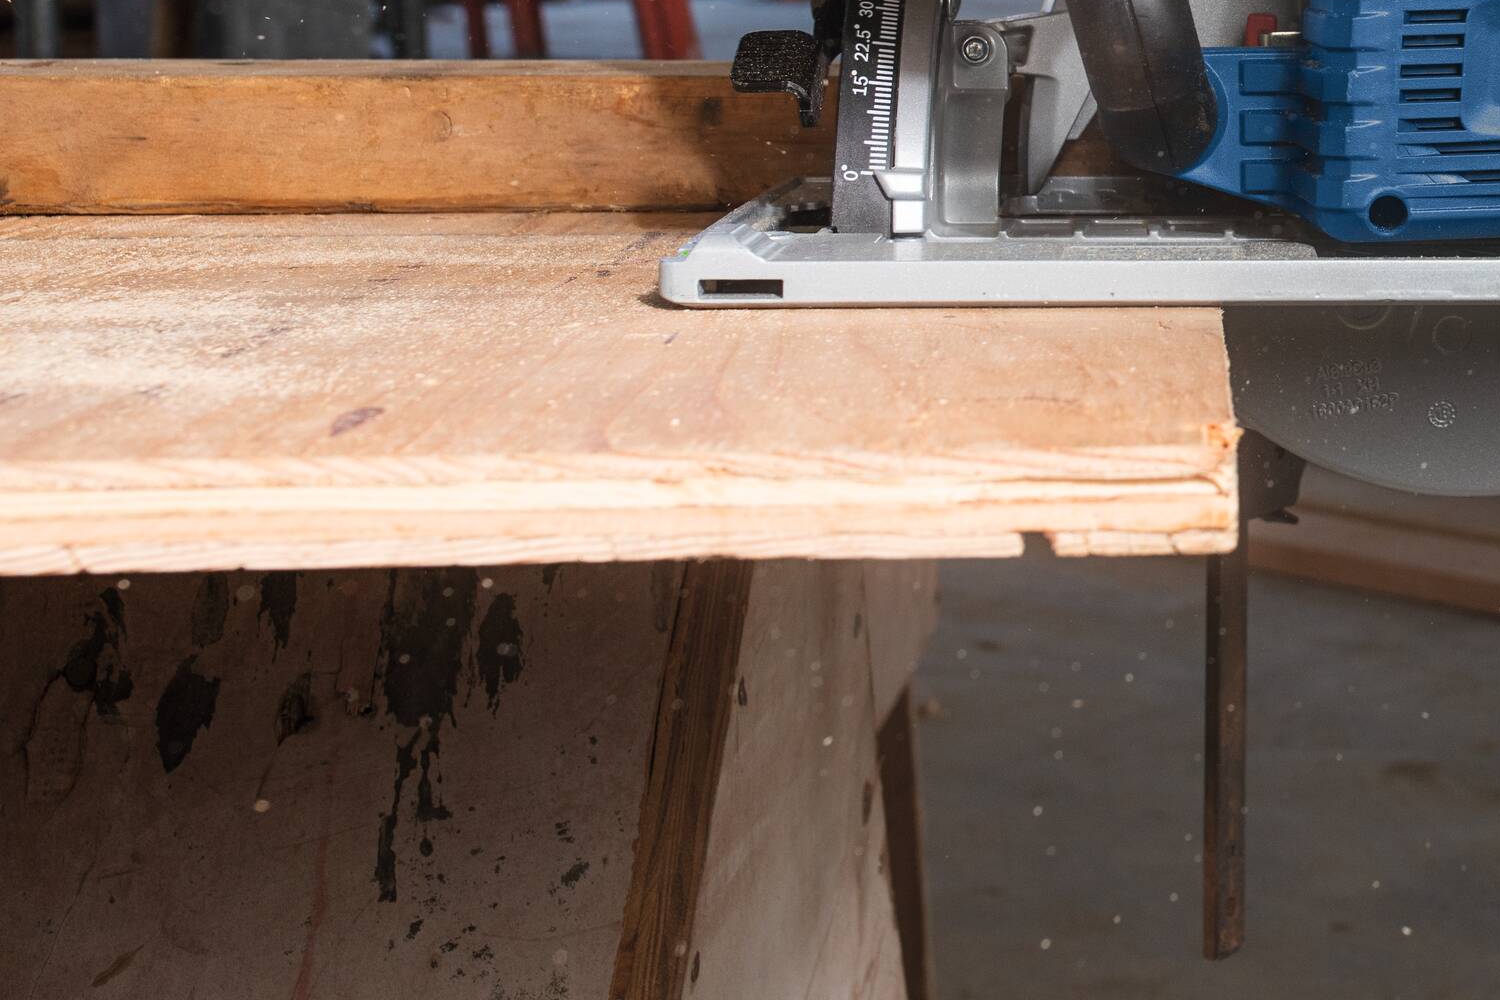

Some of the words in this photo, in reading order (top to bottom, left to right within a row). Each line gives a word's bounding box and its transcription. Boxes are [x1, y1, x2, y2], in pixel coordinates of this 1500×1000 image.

[853, 24, 872, 63] 22.5°
[851, 69, 869, 97] 15°
[840, 164, 859, 182] 0°
